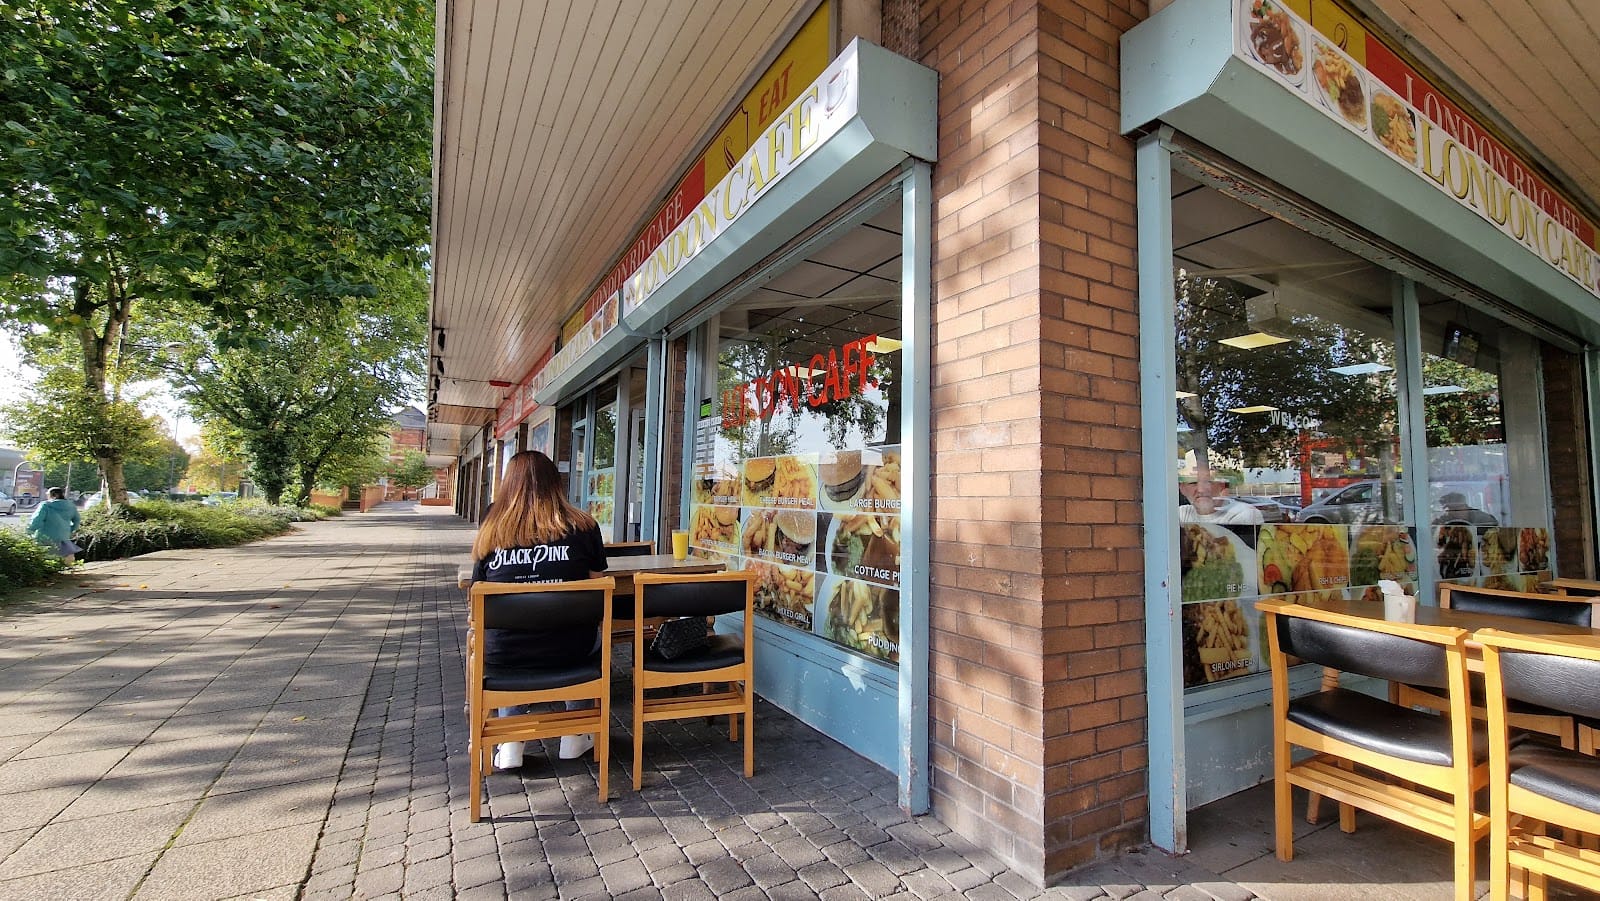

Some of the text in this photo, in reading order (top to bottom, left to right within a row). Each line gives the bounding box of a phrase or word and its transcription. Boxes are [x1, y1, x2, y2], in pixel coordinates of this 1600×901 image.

[758, 60, 794, 126] EAT
[1405, 73, 1509, 182] LONDON
[1513, 161, 1538, 205] RD
[636, 86, 818, 305] LONDON CAFE
[1419, 119, 1595, 290] LONDON CAFE
[647, 189, 684, 251] CAFE
[807, 333, 878, 407] CAFE
[778, 497, 797, 505] BURGER
[798, 497, 814, 506] MEAL
[849, 498, 901, 509] LARGE BURGE
[775, 551, 796, 562] BURGER
[854, 564, 900, 583] COTTAGE PI
[1226, 584, 1237, 592] PIE
[795, 611, 810, 624] GRILL
[1211, 660, 1236, 673] SIRLOIN
